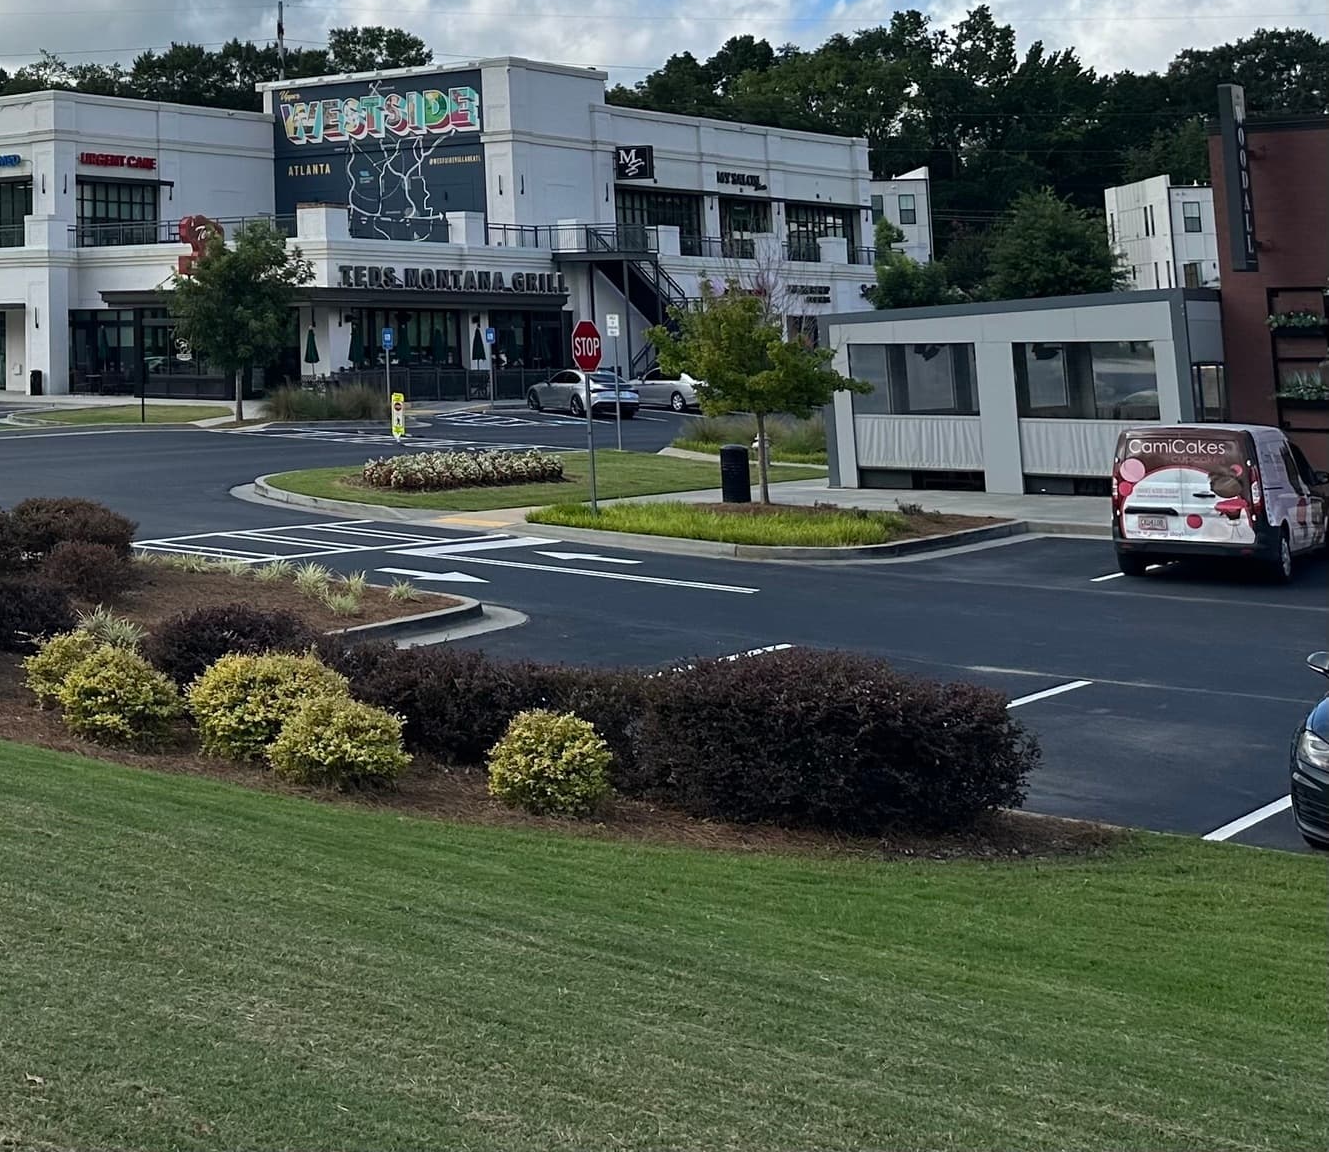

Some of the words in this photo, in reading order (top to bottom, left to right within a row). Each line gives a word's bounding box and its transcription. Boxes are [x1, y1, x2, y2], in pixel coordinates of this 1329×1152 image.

[280, 86, 480, 145] WESTSIDE
[80, 152, 126, 168] URGENT
[288, 163, 331, 176] ATLANTA
[403, 268, 504, 291] MONTANA
[511, 271, 569, 294] GRILL
[574, 336, 600, 356] STOP
[1128, 439, 1226, 455] CamiCakes
